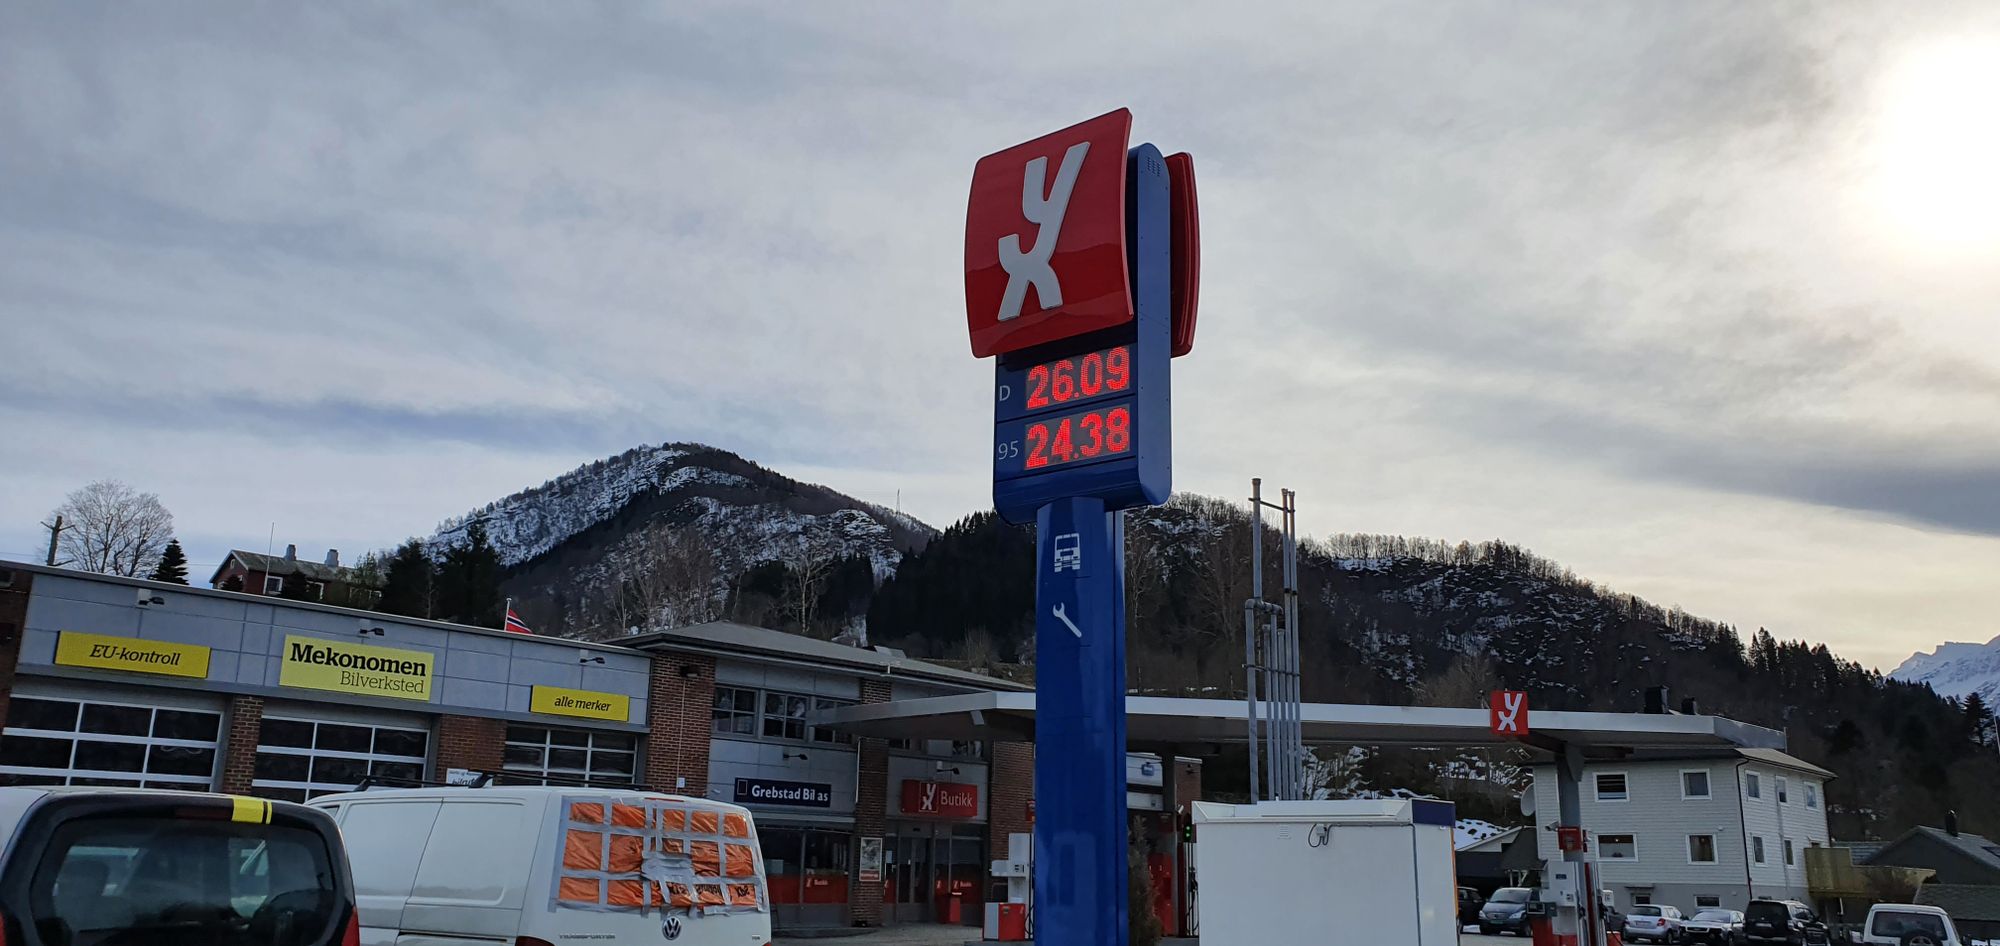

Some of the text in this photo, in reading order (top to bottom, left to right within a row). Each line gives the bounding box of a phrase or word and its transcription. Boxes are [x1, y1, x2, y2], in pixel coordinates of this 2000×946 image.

[1000, 346, 1130, 408] D 26.09
[999, 407, 1130, 468] 95 24.38
[90, 644, 181, 666] EU-kontroll
[290, 643, 426, 677] Mekonomen
[340, 670, 424, 694] Bilverksted
[554, 696, 612, 712] alle merker
[751, 785, 829, 802] Grebstad Bil as
[940, 791, 973, 808] Butikk
